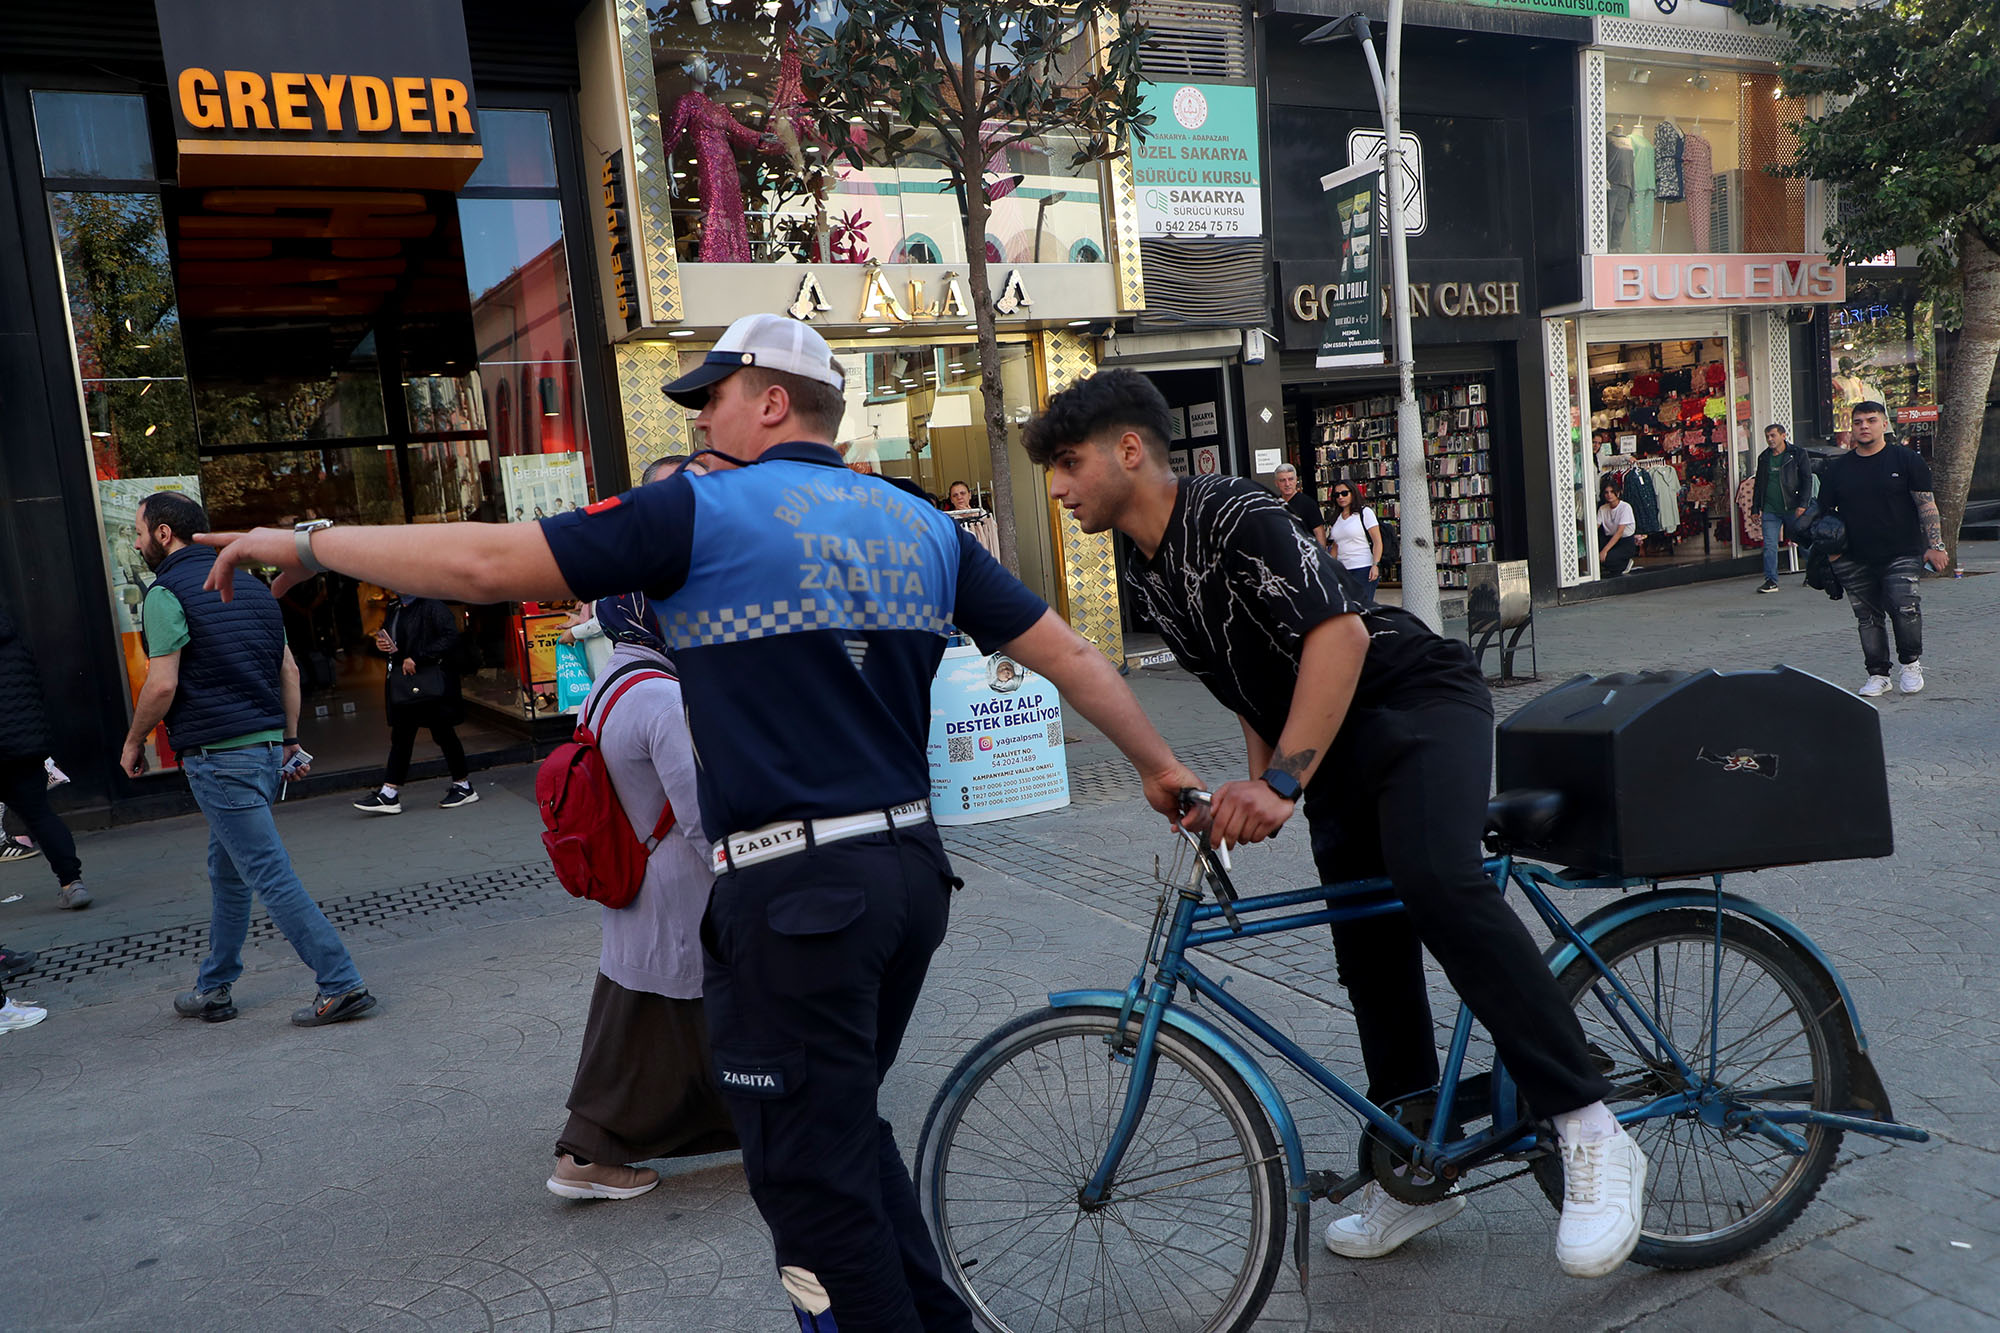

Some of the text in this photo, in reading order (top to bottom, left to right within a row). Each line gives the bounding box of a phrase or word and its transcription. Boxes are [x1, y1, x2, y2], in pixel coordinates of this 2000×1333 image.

[178, 67, 476, 135] GREYDER
[1154, 133, 1187, 141] SAKARYA
[1192, 134, 1230, 142] ADAPAZARI
[1181, 147, 1249, 161] SAKARYA
[1135, 167, 1252, 184] SÜRÜCÜ KURSU
[1169, 190, 1245, 203] SAKARYA
[1173, 206, 1245, 216] SÜRÜCÜ KURSU
[1155, 220, 1239, 232] 0 542 254 75 75
[602, 158, 632, 320] GREYDER
[1614, 261, 1837, 302] BUQLEMS
[1438, 281, 1521, 317] CASH
[516, 466, 571, 480] BE THERE
[773, 479, 929, 539] BÜYÜKŞEHİR
[794, 532, 924, 566] TRAFİK
[799, 563, 924, 597] ZABITA
[970, 695, 1042, 716] YAĞIZ ALP
[946, 706, 1060, 735] DESTEK BEKLİYOR
[973, 769, 1014, 781] KAMPANYAMIZ
[893, 802, 922, 816] ABITA
[736, 826, 807, 855] ZABITA
[722, 1070, 776, 1087] ZABITA
